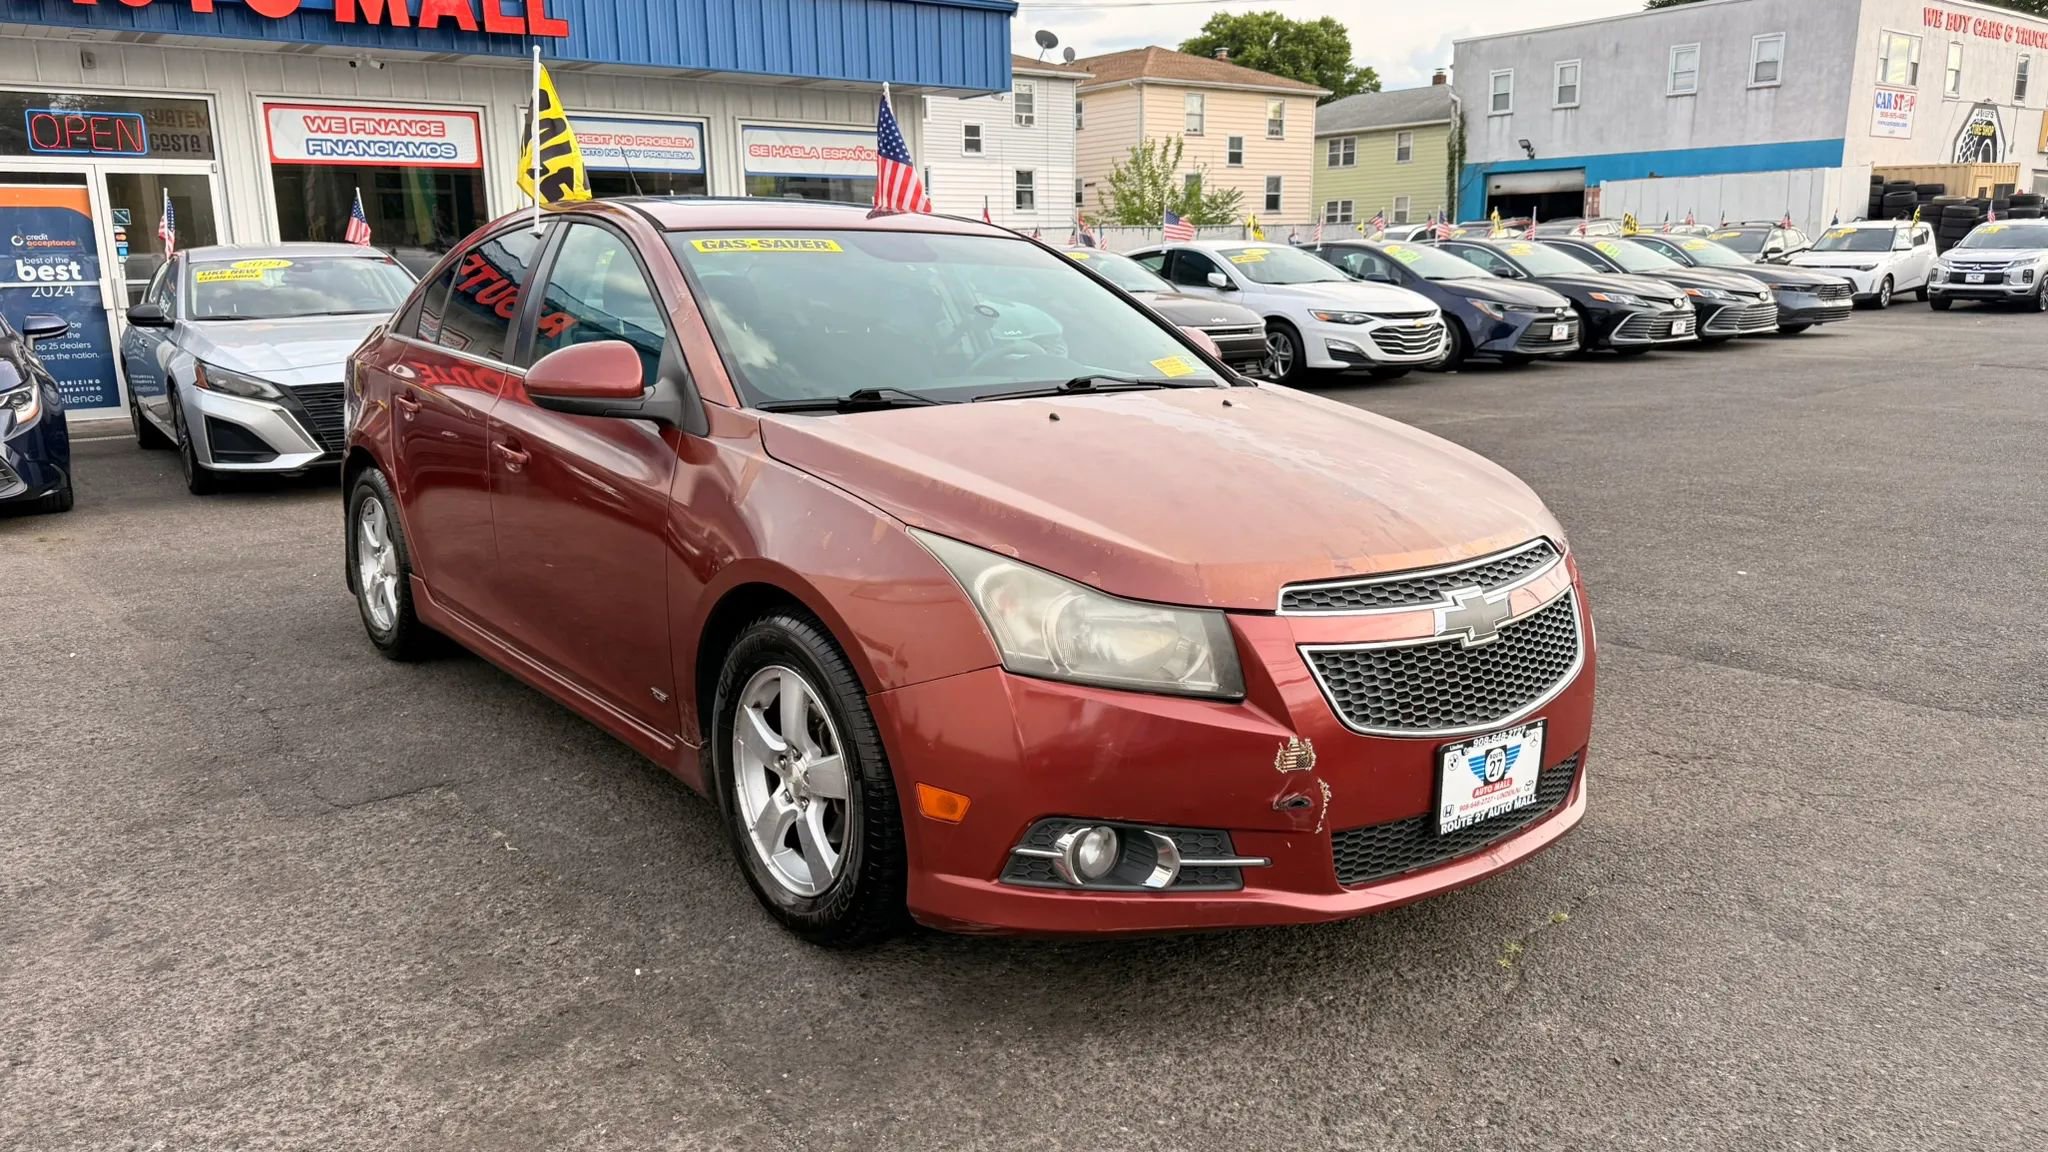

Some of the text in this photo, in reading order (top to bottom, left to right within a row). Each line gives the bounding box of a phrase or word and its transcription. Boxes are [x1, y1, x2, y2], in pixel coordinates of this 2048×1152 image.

[1923, 7, 1943, 28] WE
[1945, 12, 1972, 33] BUY
[1973, 18, 2003, 40] CARS
[1876, 91, 1892, 109] CAR
[31, 113, 143, 152] OPEN
[303, 116, 446, 137] WE FINANCE
[150, 133, 200, 153] COSTA
[306, 138, 457, 160] FINANCIAMOS
[575, 133, 694, 148] REDIT NO PROBLEM
[604, 149, 620, 157] NO
[622, 150, 642, 159] HAY
[643, 151, 694, 160] PROBLEMA
[750, 144, 878, 161] SE HABLA ESPAÑOL
[26, 240, 76, 248] acceptance
[24, 256, 44, 264] best
[16, 259, 82, 281] best
[32, 285, 75, 297] 2024
[48, 342, 59, 350] 25
[60, 341, 91, 349] dealers
[72, 351, 99, 359] nation.
[1489, 751, 1503, 760] ROUTE
[1489, 758, 1503, 778] 27
[1475, 779, 1512, 797] AUTO MALL
[1441, 794, 1537, 835] ROUTE 27 AUTO MALL
